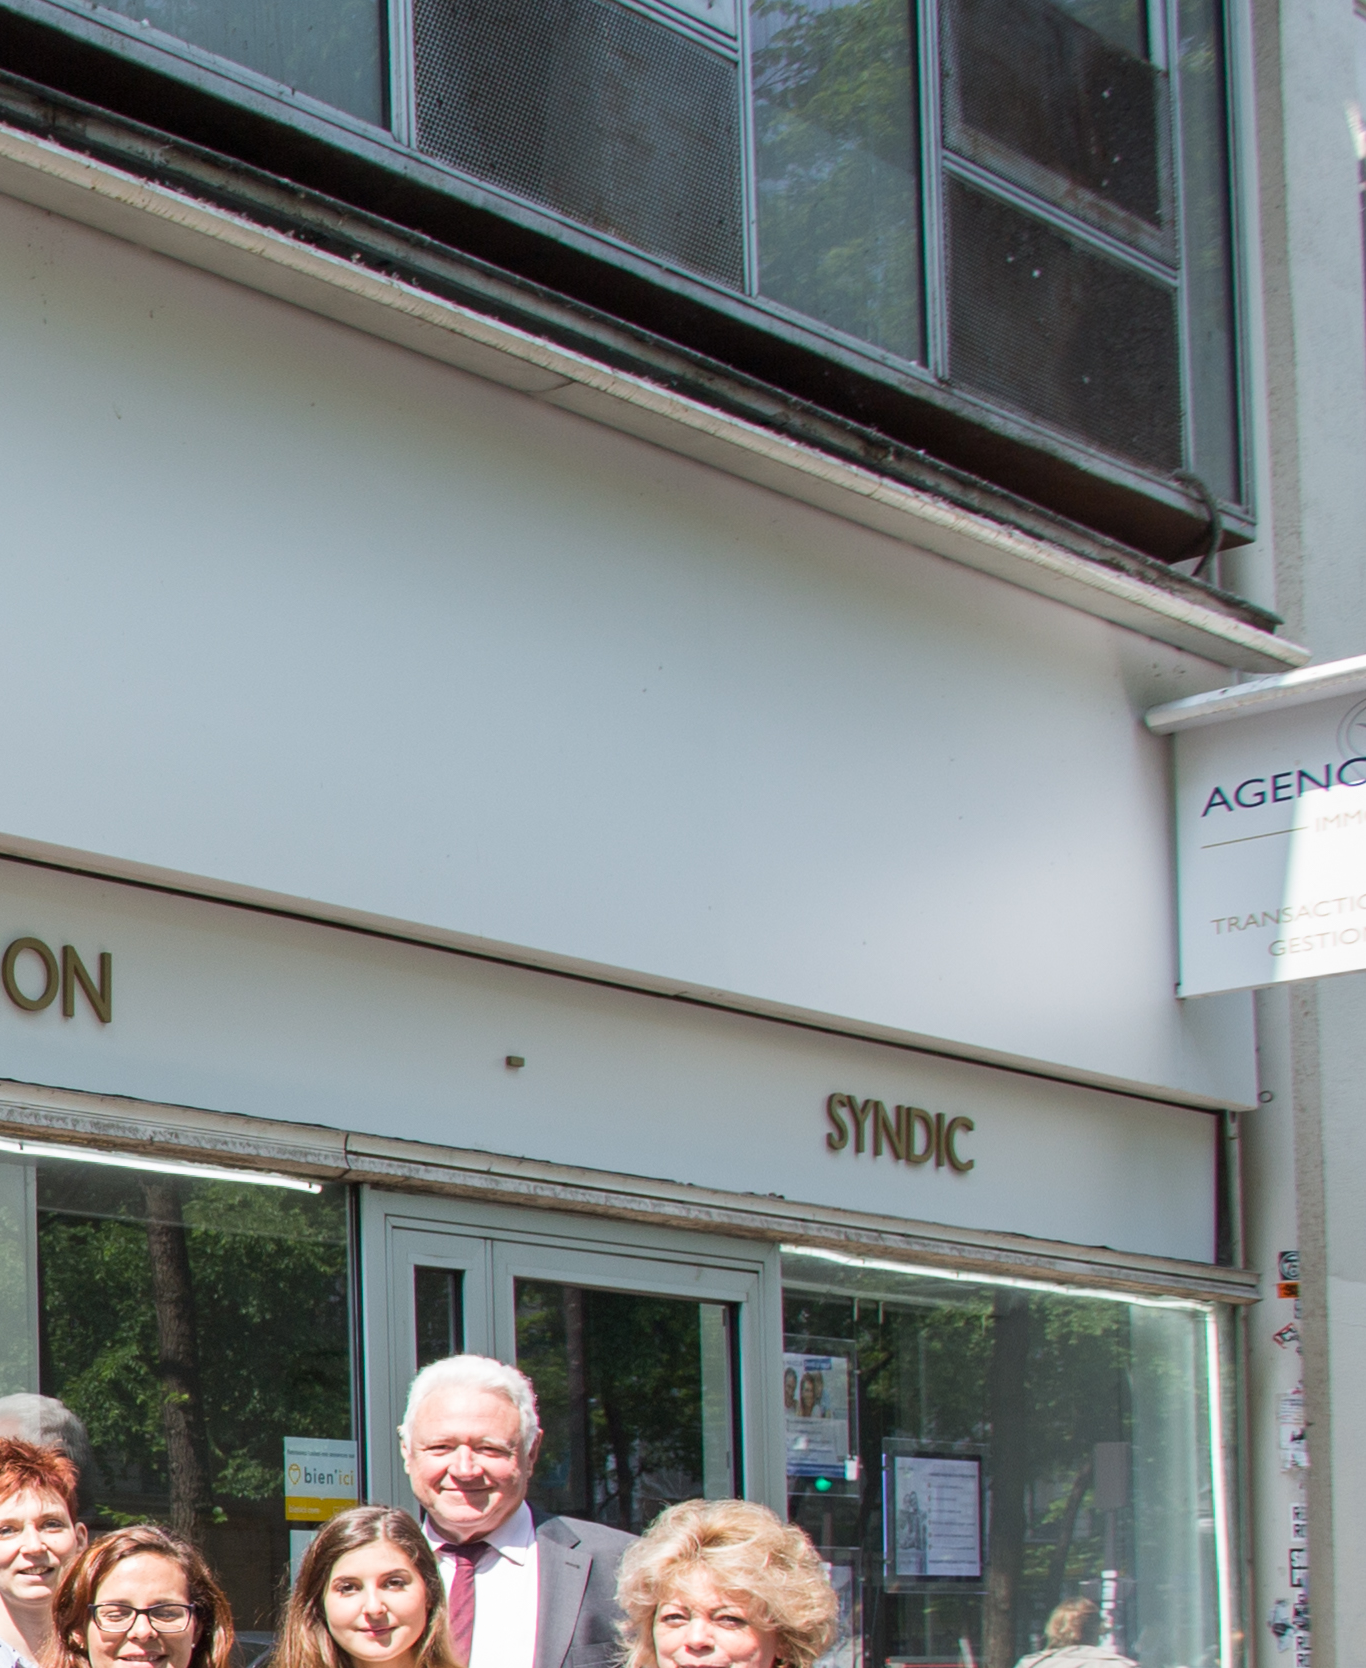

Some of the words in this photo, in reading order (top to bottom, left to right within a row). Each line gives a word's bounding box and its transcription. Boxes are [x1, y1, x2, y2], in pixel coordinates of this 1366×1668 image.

[1315, 808, 1366, 833] IMM
[1267, 926, 1366, 958] GESTIO
[825, 1091, 976, 1173] SYNDIC
[303, 1465, 354, 1486] bien'ici
